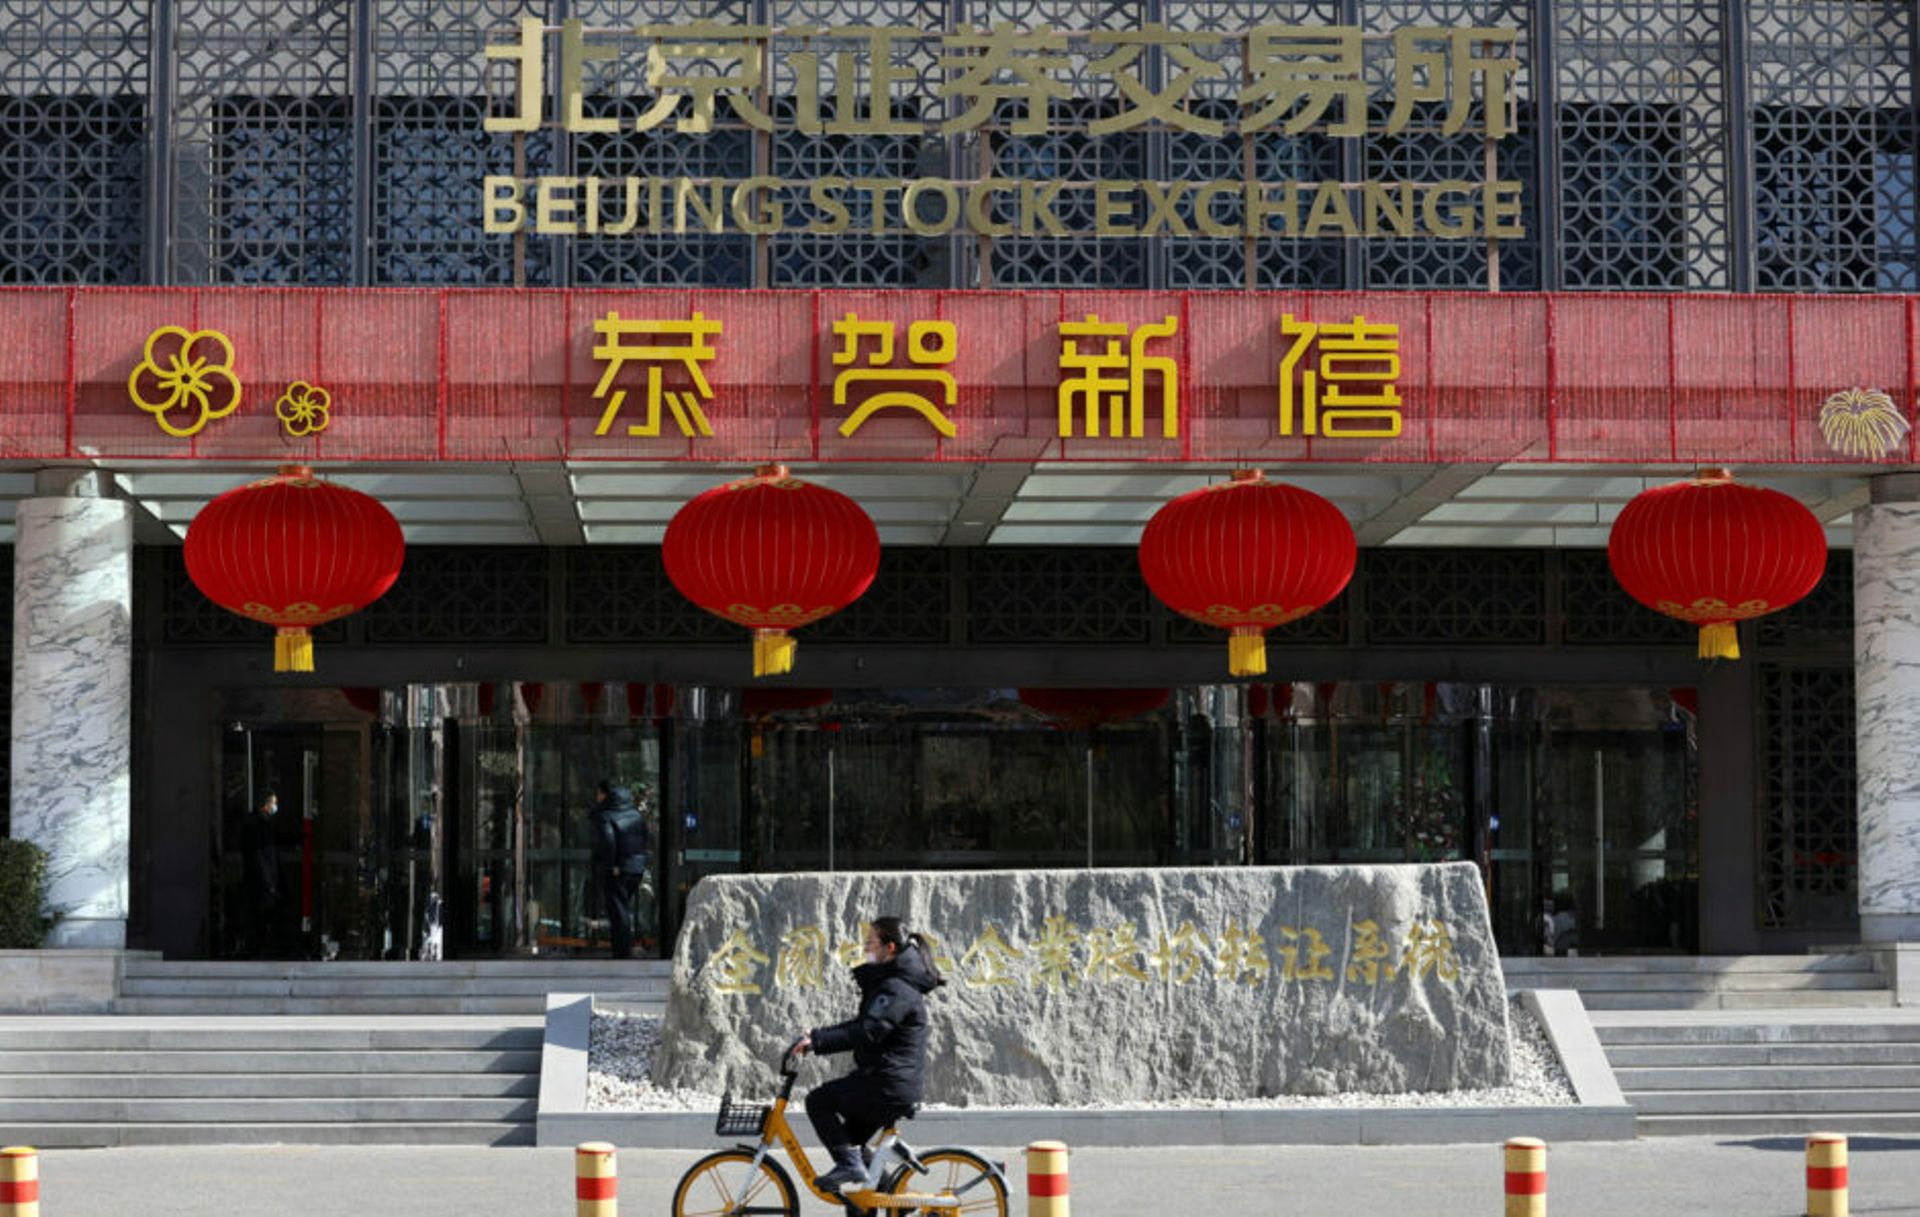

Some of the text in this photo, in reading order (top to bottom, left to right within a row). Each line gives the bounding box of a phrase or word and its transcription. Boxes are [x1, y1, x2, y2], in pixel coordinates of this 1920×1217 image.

[484, 18, 1520, 139] 北京证券交易所
[484, 176, 1525, 238] BEIJING STOCK EXCHANGE
[594, 311, 1402, 438] 恭贺新禧
